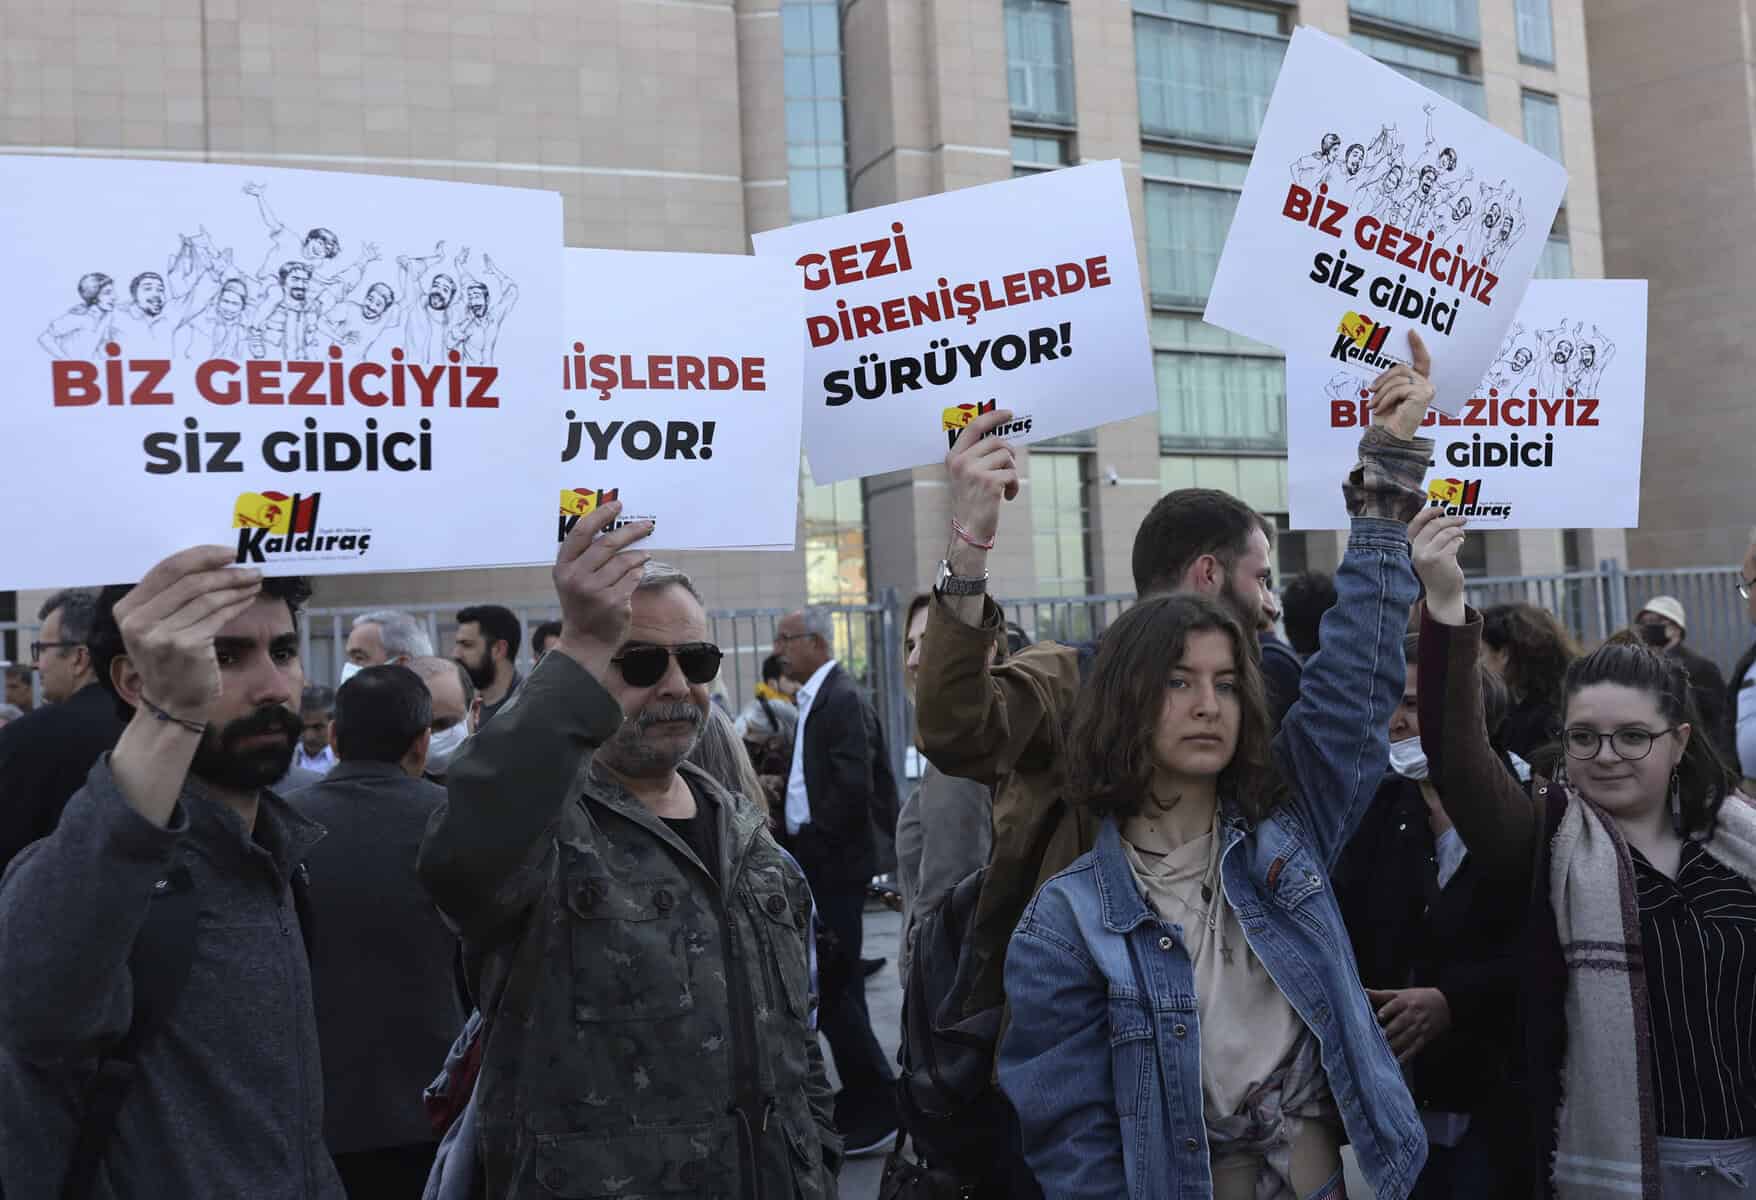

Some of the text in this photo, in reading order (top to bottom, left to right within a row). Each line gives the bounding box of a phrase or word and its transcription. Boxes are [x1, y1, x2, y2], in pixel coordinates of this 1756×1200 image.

[795, 221, 912, 291] GEZİ
[1282, 183, 1499, 306] BİZ GEZİCİYİZ
[806, 255, 1111, 348] DİRENİŞLERDE
[1309, 249, 1460, 336] SİZ GİDİCİ
[51, 342, 500, 409] BİZ GEZİCİYİZ
[563, 341, 766, 401] İŞLERDE
[823, 322, 1073, 407] SÜRÜYOR!
[1330, 321, 1397, 369] Kaldır
[143, 416, 432, 475] SİZ GİDİCİ
[561, 409, 716, 462] YOR!
[1446, 433, 1553, 467] GİDİCİ
[235, 492, 371, 563] Kaldıraç
